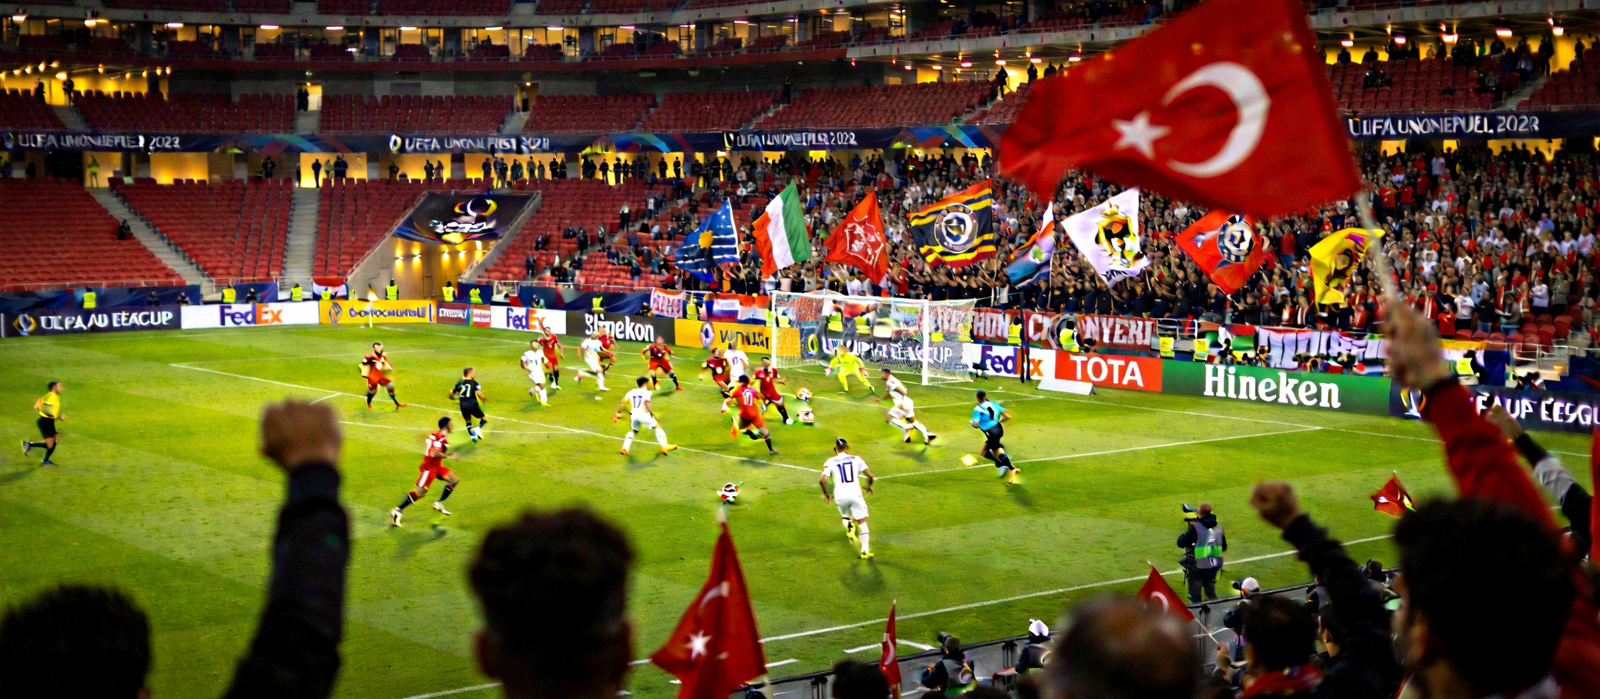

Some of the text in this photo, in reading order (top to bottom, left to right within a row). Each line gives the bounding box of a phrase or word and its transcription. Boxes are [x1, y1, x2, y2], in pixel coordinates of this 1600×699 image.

[219, 304, 283, 326] FedEx
[506, 306, 545, 331] FedE
[1070, 355, 1144, 387] TOTA
[1203, 364, 1342, 409] Hineken
[836, 461, 855, 484] 10
